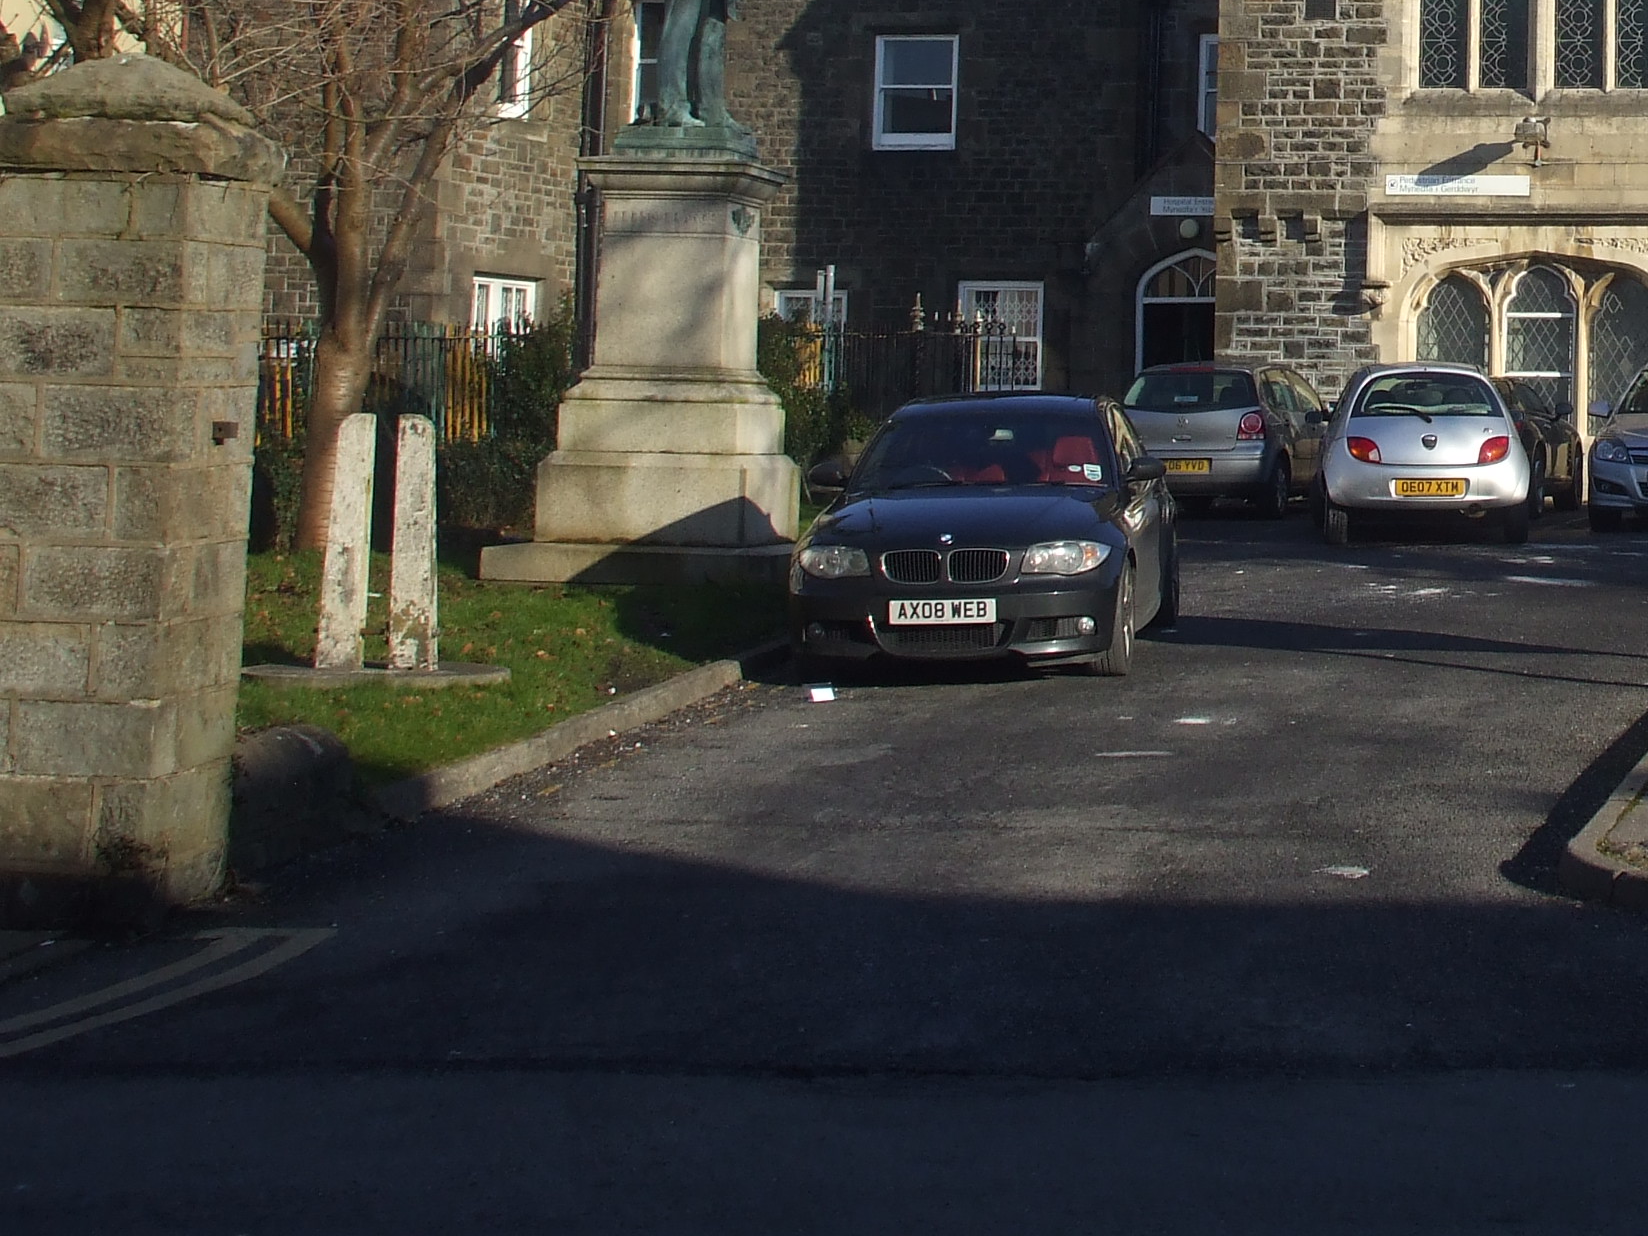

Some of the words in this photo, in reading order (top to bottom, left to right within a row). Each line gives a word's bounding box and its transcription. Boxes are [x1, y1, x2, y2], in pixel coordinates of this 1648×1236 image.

[1185, 460, 1205, 470] YVD
[1401, 481, 1432, 492] OE07
[898, 602, 945, 619] AX08
[951, 601, 988, 618] WEB
